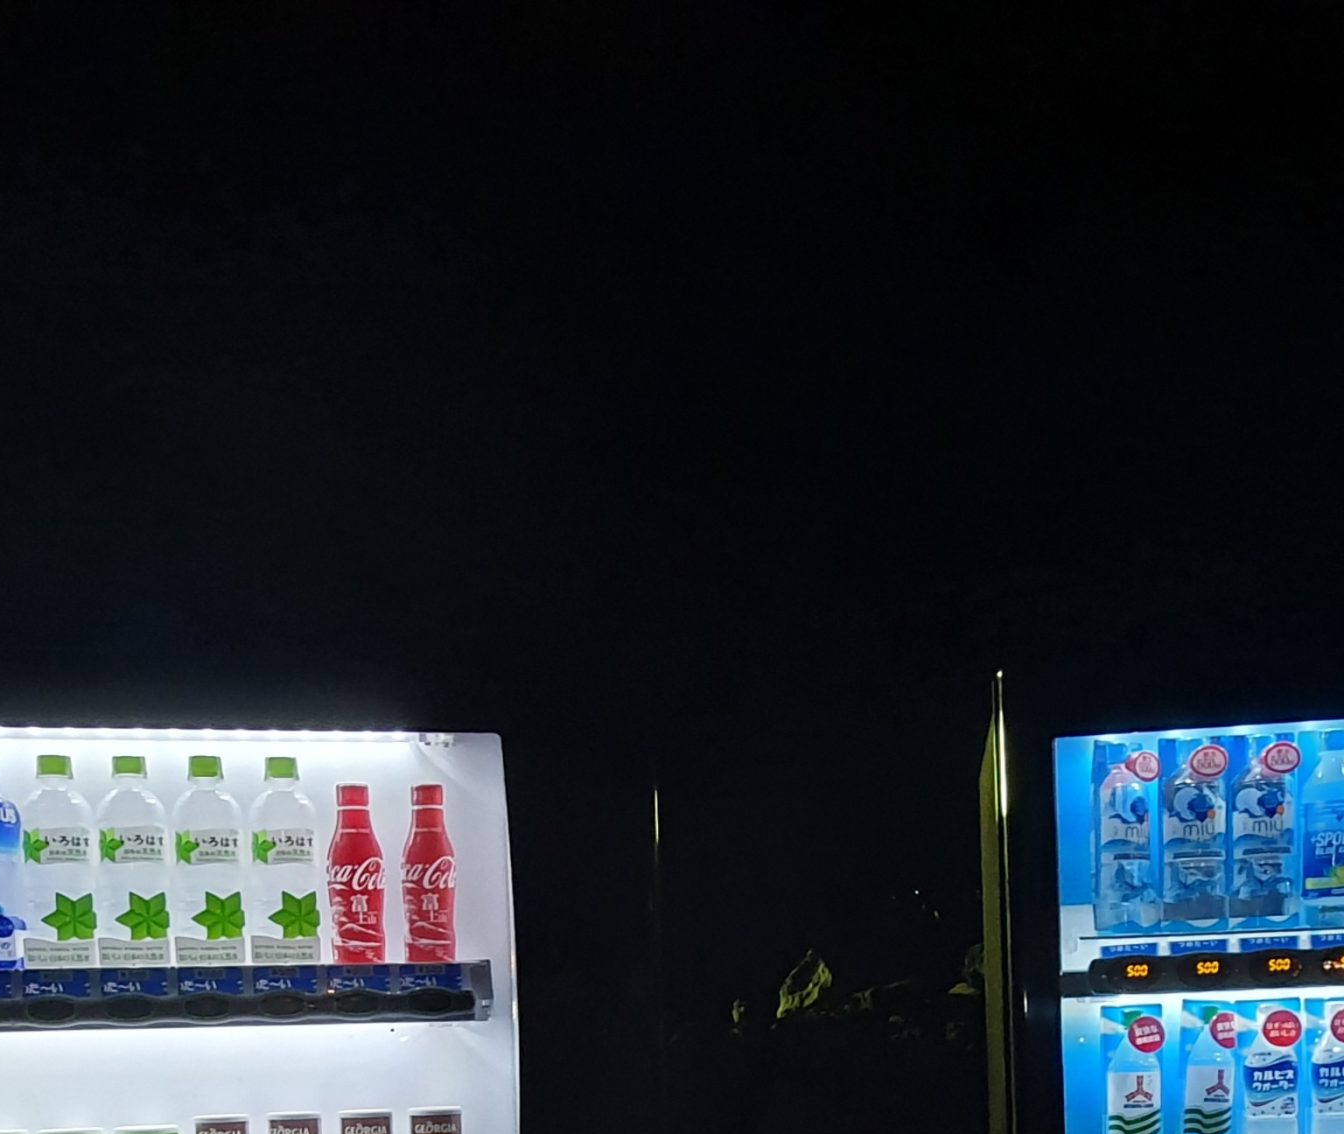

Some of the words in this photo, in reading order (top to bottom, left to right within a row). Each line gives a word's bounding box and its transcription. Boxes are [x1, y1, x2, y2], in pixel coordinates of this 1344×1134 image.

[1126, 964, 1149, 977] 500
[1196, 961, 1219, 974] 500
[1268, 958, 1291, 971] 500
[1253, 1070, 1294, 1081] カルピス
